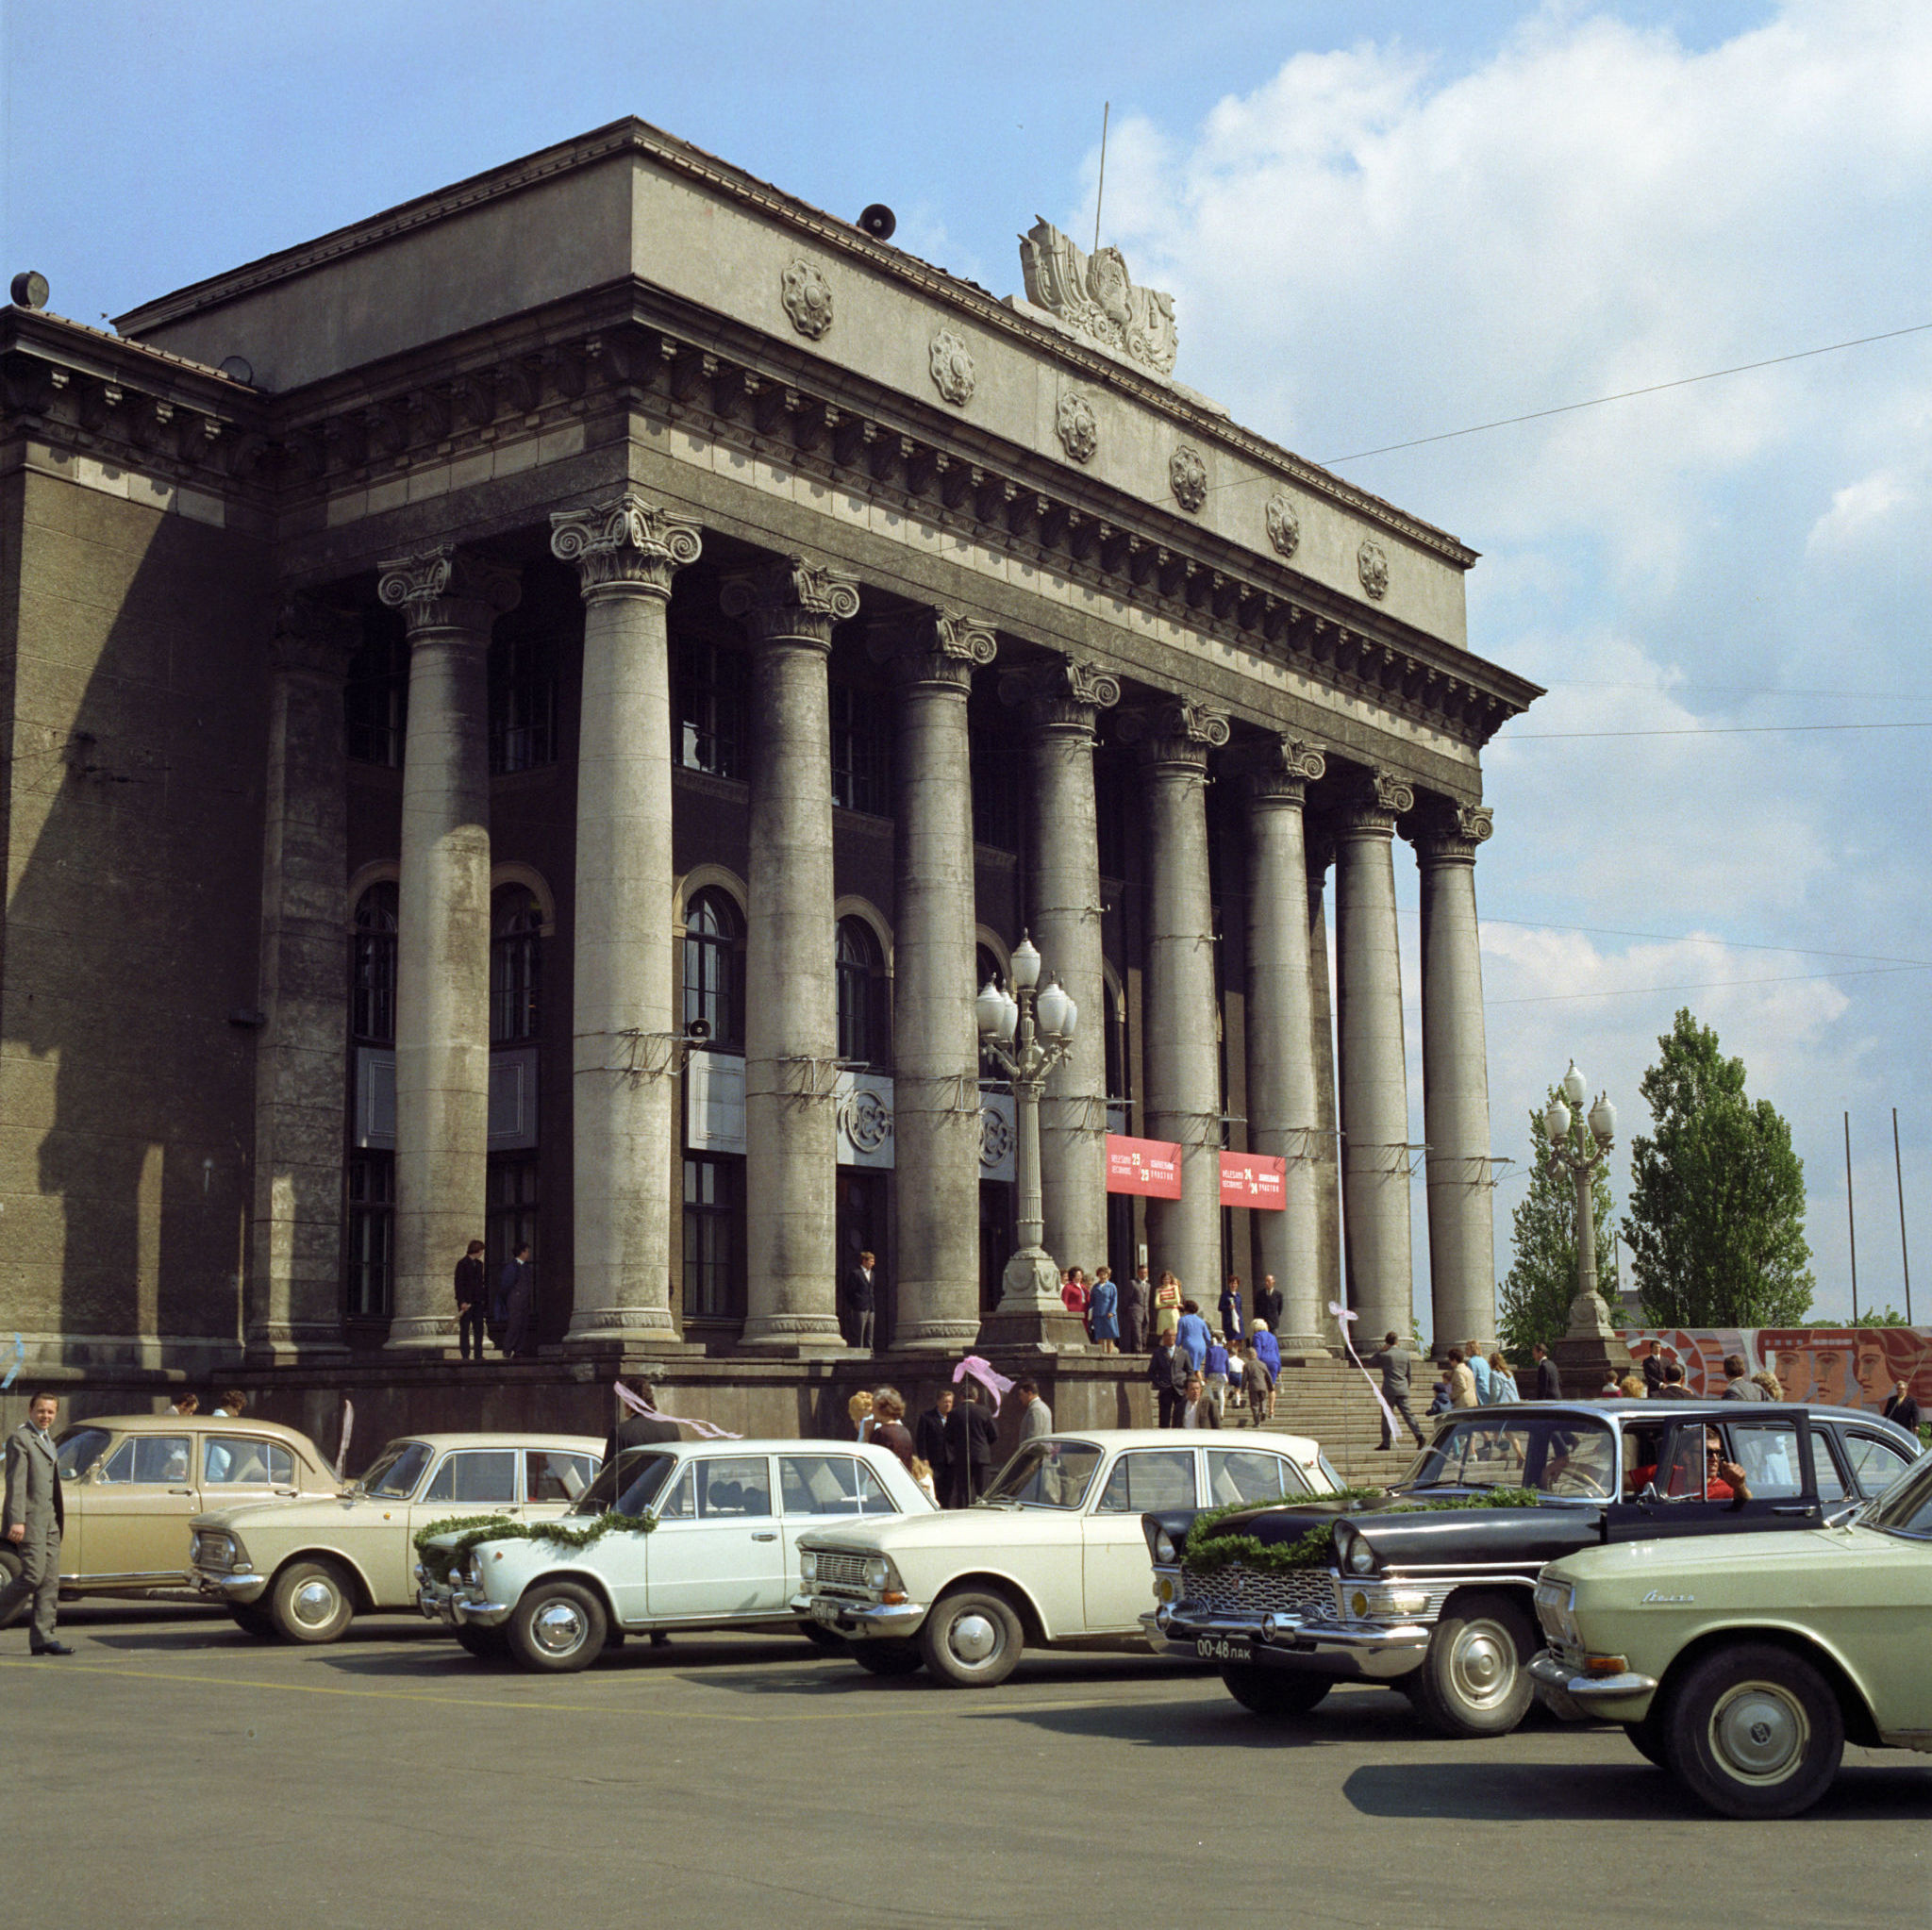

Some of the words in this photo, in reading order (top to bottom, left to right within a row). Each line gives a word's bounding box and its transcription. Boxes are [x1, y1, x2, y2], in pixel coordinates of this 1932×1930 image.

[1141, 1169, 1150, 1181] 25
[1250, 1182, 1258, 1194] 24
[1197, 1639, 1229, 1658] 00-48
